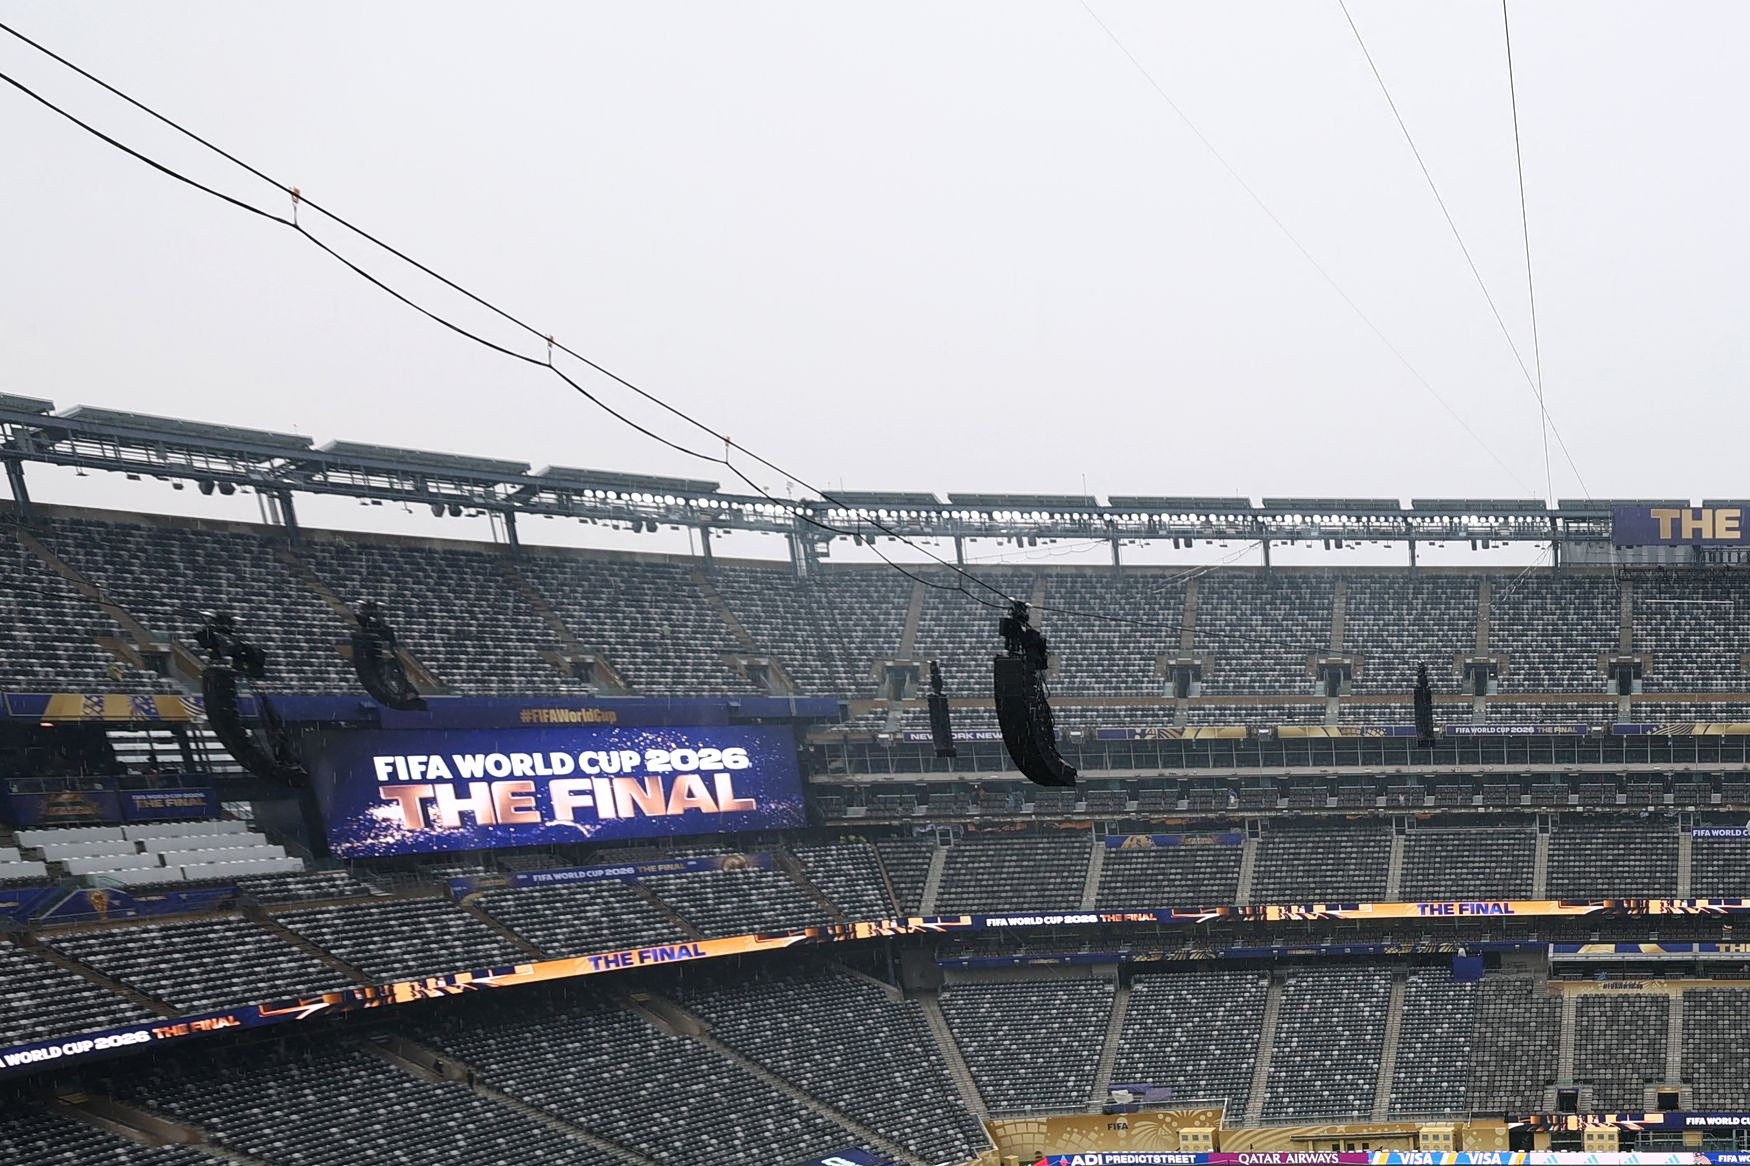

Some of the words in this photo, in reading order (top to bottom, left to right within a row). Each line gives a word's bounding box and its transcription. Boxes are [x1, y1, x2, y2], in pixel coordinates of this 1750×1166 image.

[1651, 508, 1741, 539] THE
[520, 708, 617, 725] #FIFAWorldCup
[951, 732, 974, 740] ORK
[373, 754, 453, 781] FIFA
[453, 752, 575, 779] WORLD
[579, 750, 642, 774] CUP
[645, 747, 749, 772] 2026
[379, 780, 541, 830] THE
[549, 773, 757, 821] FINAL
[1693, 829, 1711, 837] FIFA
[1711, 829, 1742, 837] WORLD
[533, 873, 552, 882] FIFA
[552, 871, 586, 881] WORLD
[587, 869, 604, 879] CUP
[604, 867, 635, 876] 2026
[637, 864, 656, 873] THE
[658, 862, 687, 872] FINAL
[1417, 904, 1454, 915] THE
[1458, 903, 1515, 915] FINAL
[986, 918, 1007, 927] FIFA
[1007, 917, 1043, 925] WORLD
[1044, 916, 1064, 925] CUP
[1064, 915, 1097, 923] 2026
[1100, 914, 1124, 922] THE
[1125, 913, 1156, 921] FINAL
[588, 951, 634, 971] THE
[638, 943, 706, 965] FINAL
[5, 1046, 62, 1067] WORLD
[63, 1041, 94, 1054] CUP
[94, 1031, 150, 1049] 2026
[153, 1026, 189, 1039] THE
[190, 1015, 241, 1032] FINAL
[1107, 1122, 1129, 1131] FIFA
[1686, 1117, 1706, 1126] FIFA
[1706, 1117, 1739, 1126] WORLD
[1071, 1154, 1103, 1166] ADI
[1105, 1154, 1197, 1165] PREDICTSTREET
[1238, 1153, 1282, 1165] QATAR
[1286, 1152, 1339, 1165] AIRWAYS
[1400, 1153, 1433, 1165] VISA
[1468, 1153, 1501, 1165] VISA
[1718, 1154, 1737, 1163] FIFA
